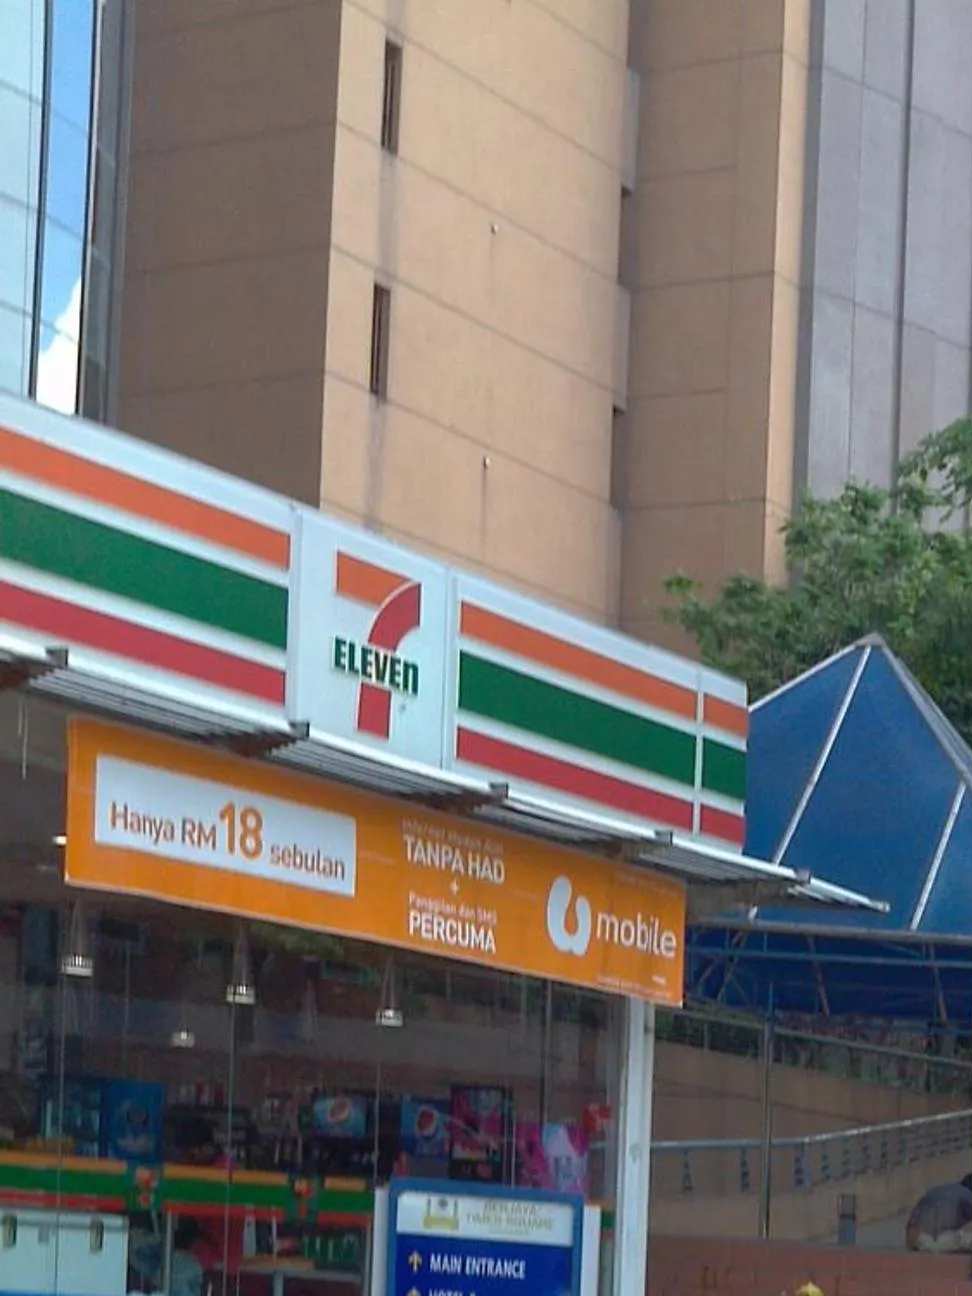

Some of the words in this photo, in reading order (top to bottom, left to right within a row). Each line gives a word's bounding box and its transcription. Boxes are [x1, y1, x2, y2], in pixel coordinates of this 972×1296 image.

[110, 801, 175, 845] Hanya
[181, 818, 217, 850] RM
[219, 800, 263, 861] 18
[270, 842, 346, 880] sebulan
[403, 834, 465, 876] TANPA
[468, 850, 505, 885] HAD
[408, 910, 497, 955] PERCUMA
[596, 911, 677, 959] mobile
[429, 1252, 462, 1275] MAIN
[465, 1257, 526, 1280] ENTRANCE
